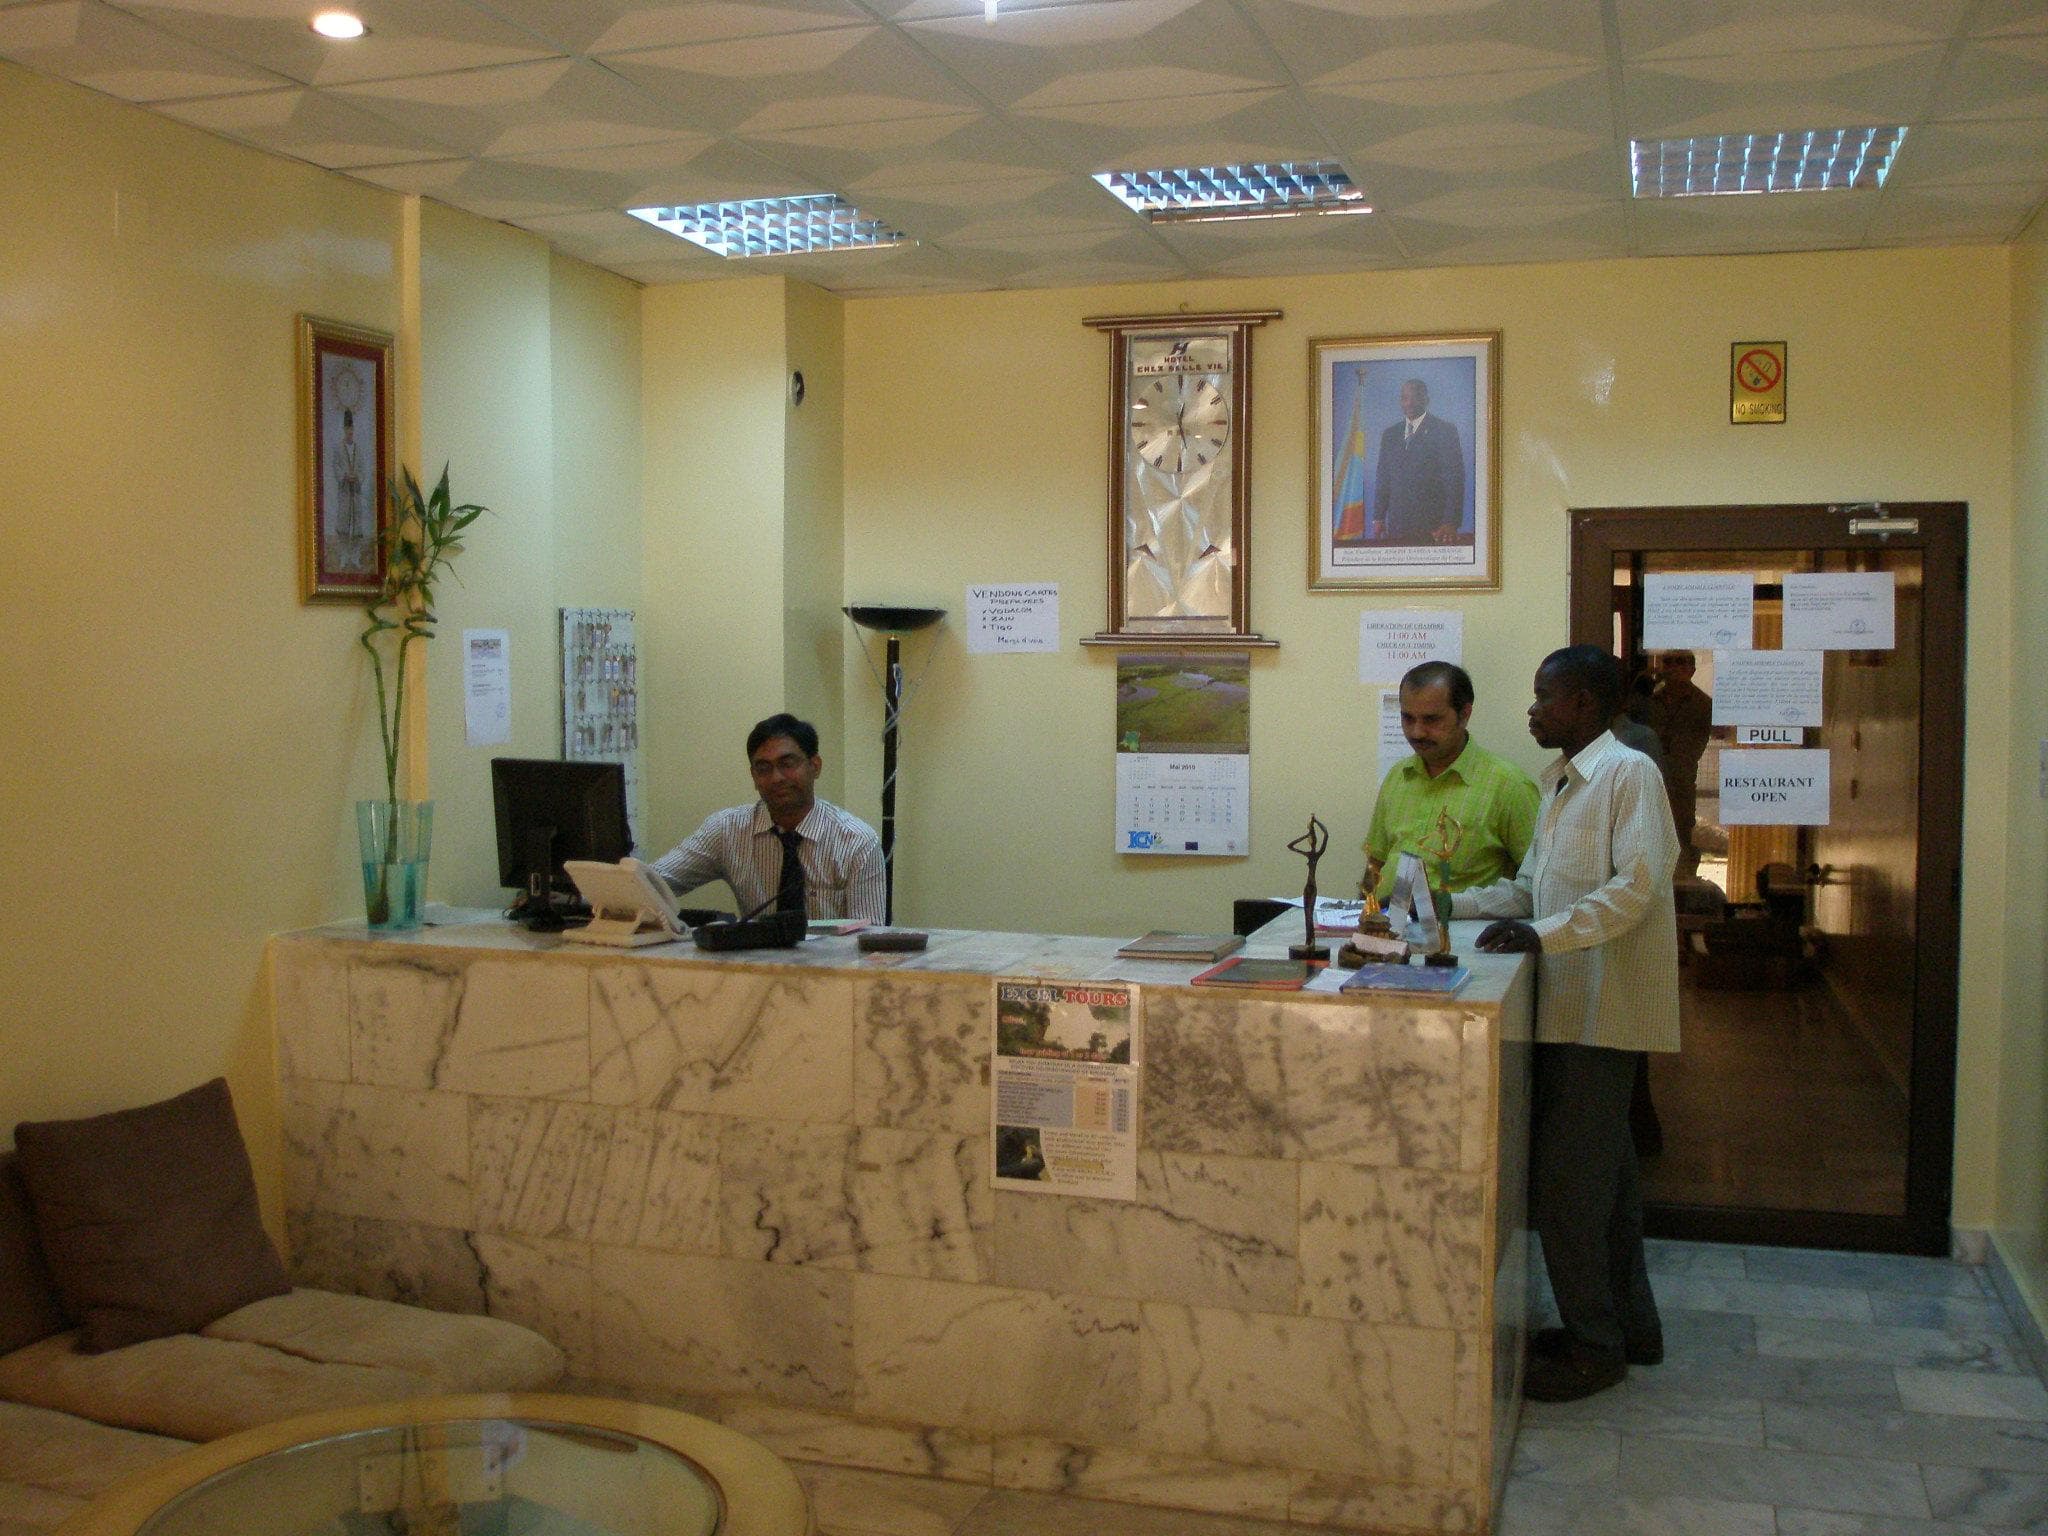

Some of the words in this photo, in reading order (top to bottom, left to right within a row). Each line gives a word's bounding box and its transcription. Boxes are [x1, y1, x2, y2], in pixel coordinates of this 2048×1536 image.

[1164, 355, 1195, 364] HOTEL
[1137, 365, 1164, 373] CHEZ
[1168, 363, 1202, 372] BELLE
[1207, 362, 1223, 370] VIE
[1735, 403, 1746, 415] NO
[1749, 403, 1783, 415] SMOKING
[1411, 632, 1427, 640] AM
[1411, 651, 1427, 659] AM
[1749, 728, 1792, 741] PULL
[1724, 776, 1815, 788] RESTAURANT
[1751, 791, 1788, 802] OPEN
[1063, 989, 1129, 1007] TOURS
